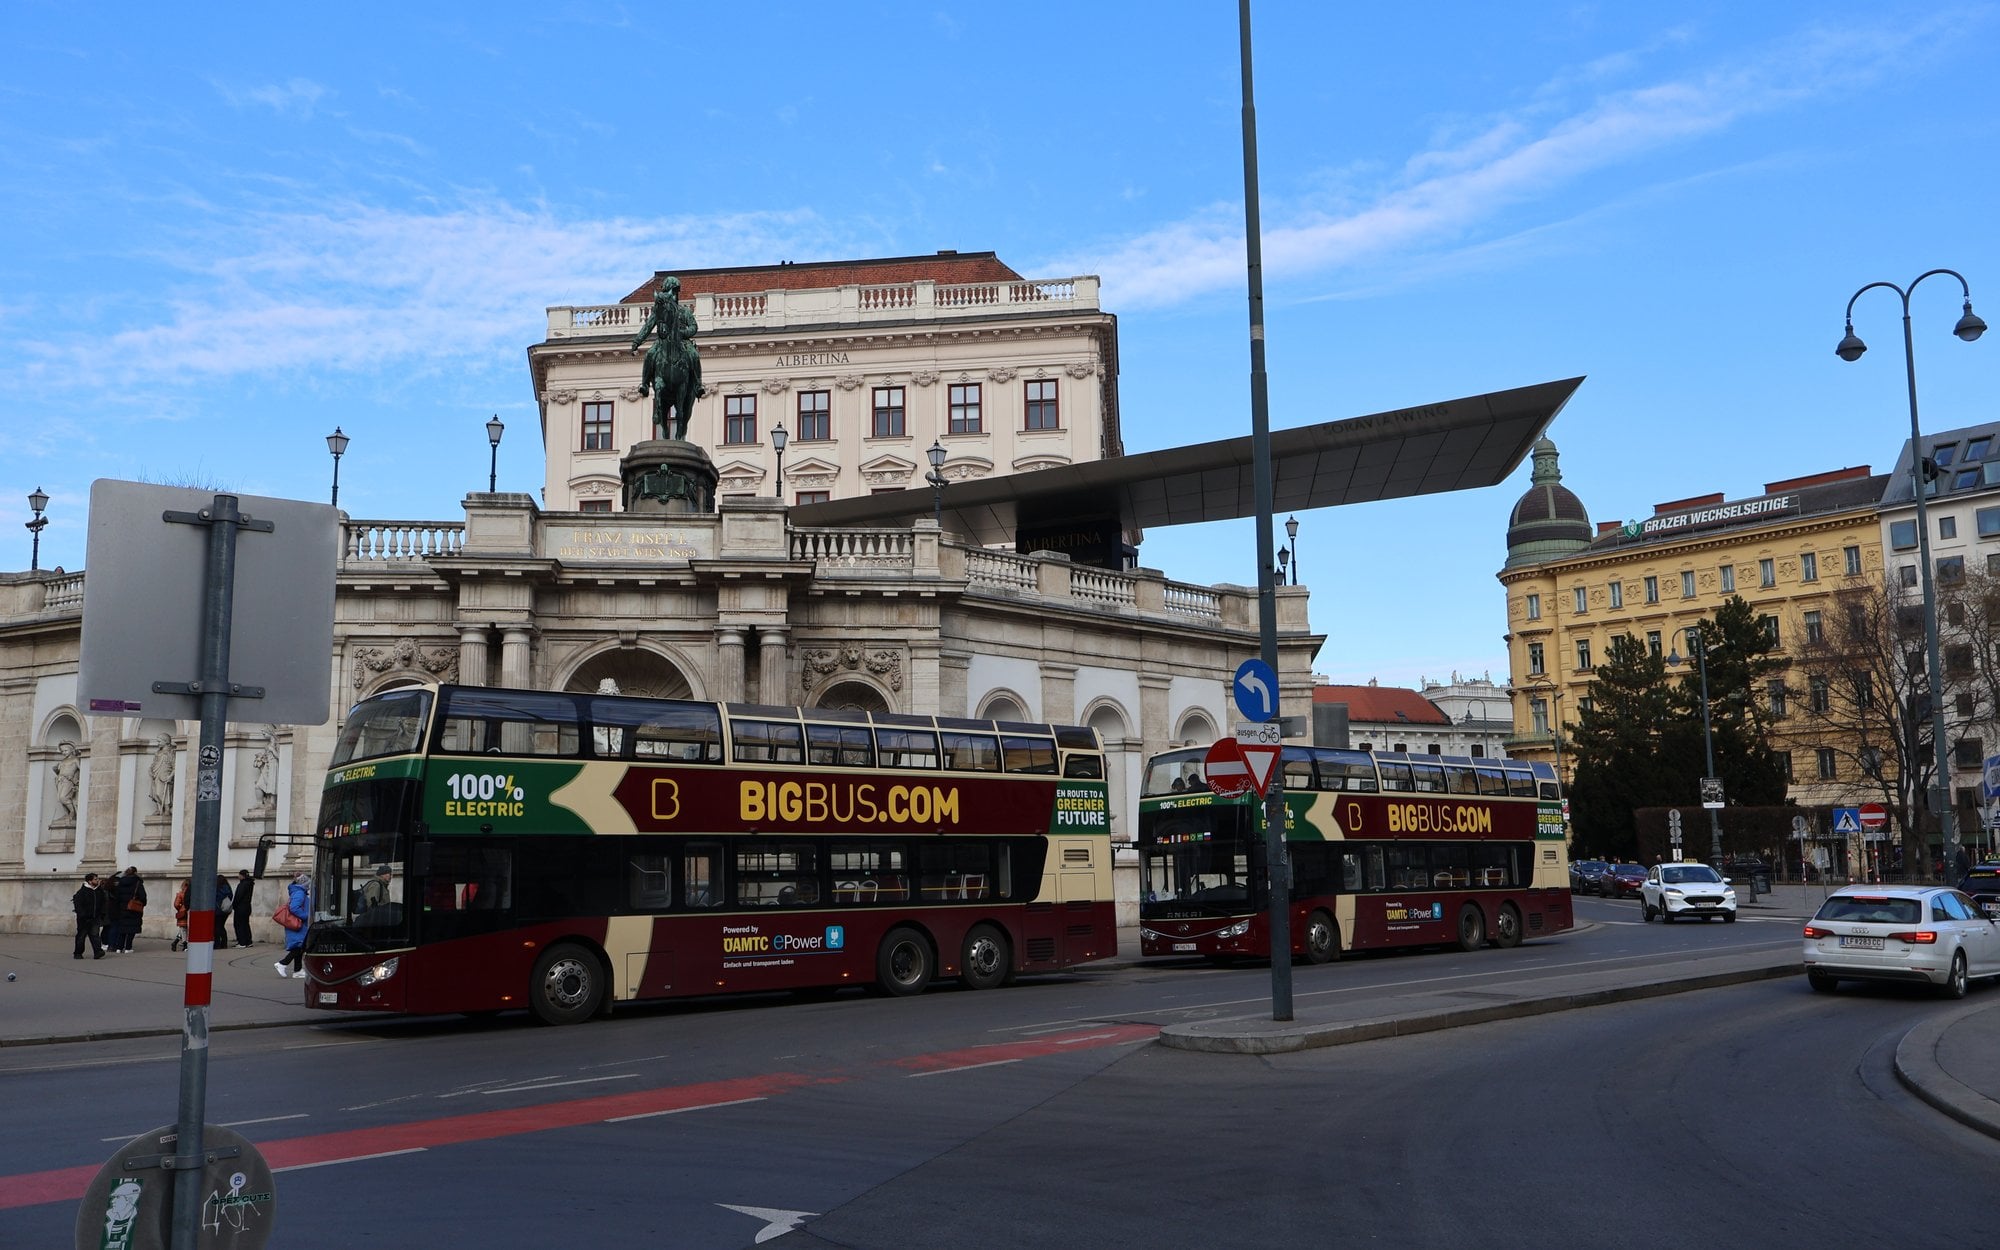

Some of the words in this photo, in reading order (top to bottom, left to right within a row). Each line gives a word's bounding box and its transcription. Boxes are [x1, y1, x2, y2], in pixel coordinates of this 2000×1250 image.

[776, 352, 850, 367] ALBERTINA
[1644, 514, 1687, 533] GRAZER
[1690, 496, 1790, 525] WECHSELSEITIGE
[573, 531, 623, 545] FRANZ
[629, 531, 673, 546] JOSEF
[634, 546, 665, 558] WIEN
[345, 765, 377, 781] ELECTRIC
[446, 773, 524, 801] 100%
[1056, 789, 1066, 798] EN
[1067, 790, 1089, 798] ROUTE
[1089, 790, 1098, 798] TO
[445, 801, 524, 817] ELECTRIC
[740, 780, 959, 824] BIGBUS.COM
[1057, 798, 1105, 811] GREENER
[1160, 801, 1177, 810] 100%
[1177, 796, 1213, 808] ELECTRIC
[1057, 811, 1106, 826] FUTURE
[1387, 804, 1492, 833] BIGBUS.COM
[1538, 814, 1563, 823] GREENER
[1538, 823, 1564, 834] FUTURE
[723, 926, 750, 934] Powered
[751, 925, 759, 934] by
[773, 934, 823, 950] ePower
[723, 961, 742, 969] Einfach
[752, 959, 781, 967] transparent
[780, 958, 795, 966] laden
